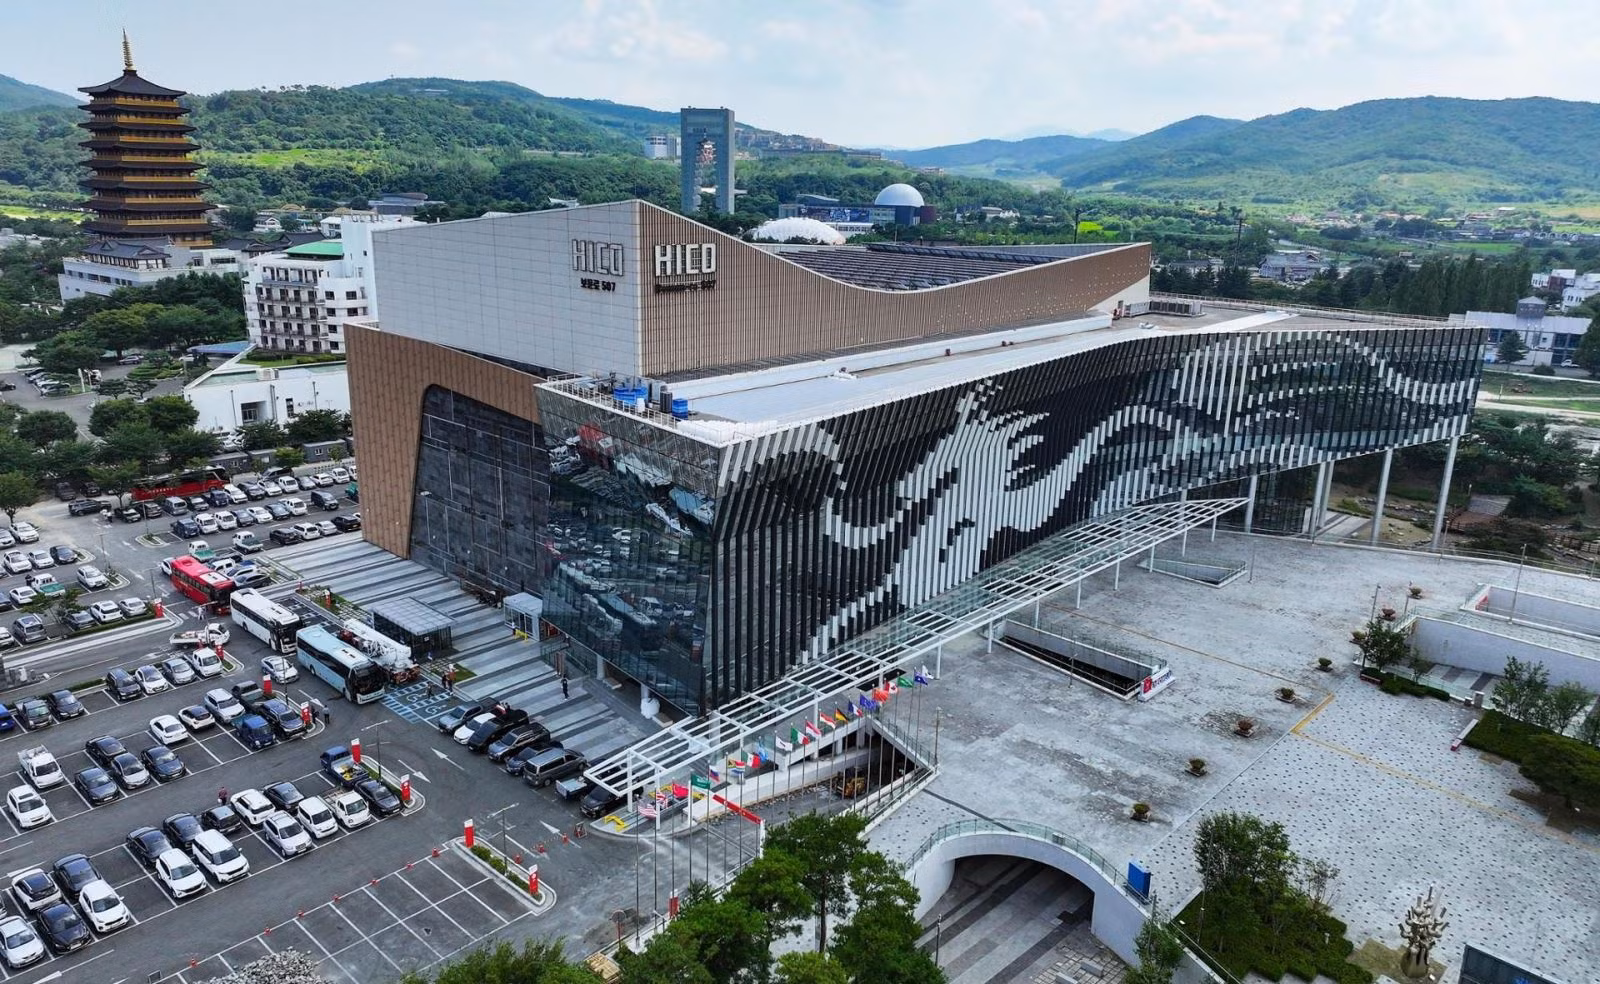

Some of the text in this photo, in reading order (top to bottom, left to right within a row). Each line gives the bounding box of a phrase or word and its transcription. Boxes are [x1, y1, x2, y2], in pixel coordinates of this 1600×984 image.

[572, 239, 624, 276] HICO
[655, 243, 716, 276] HICO
[602, 280, 616, 292] 507
